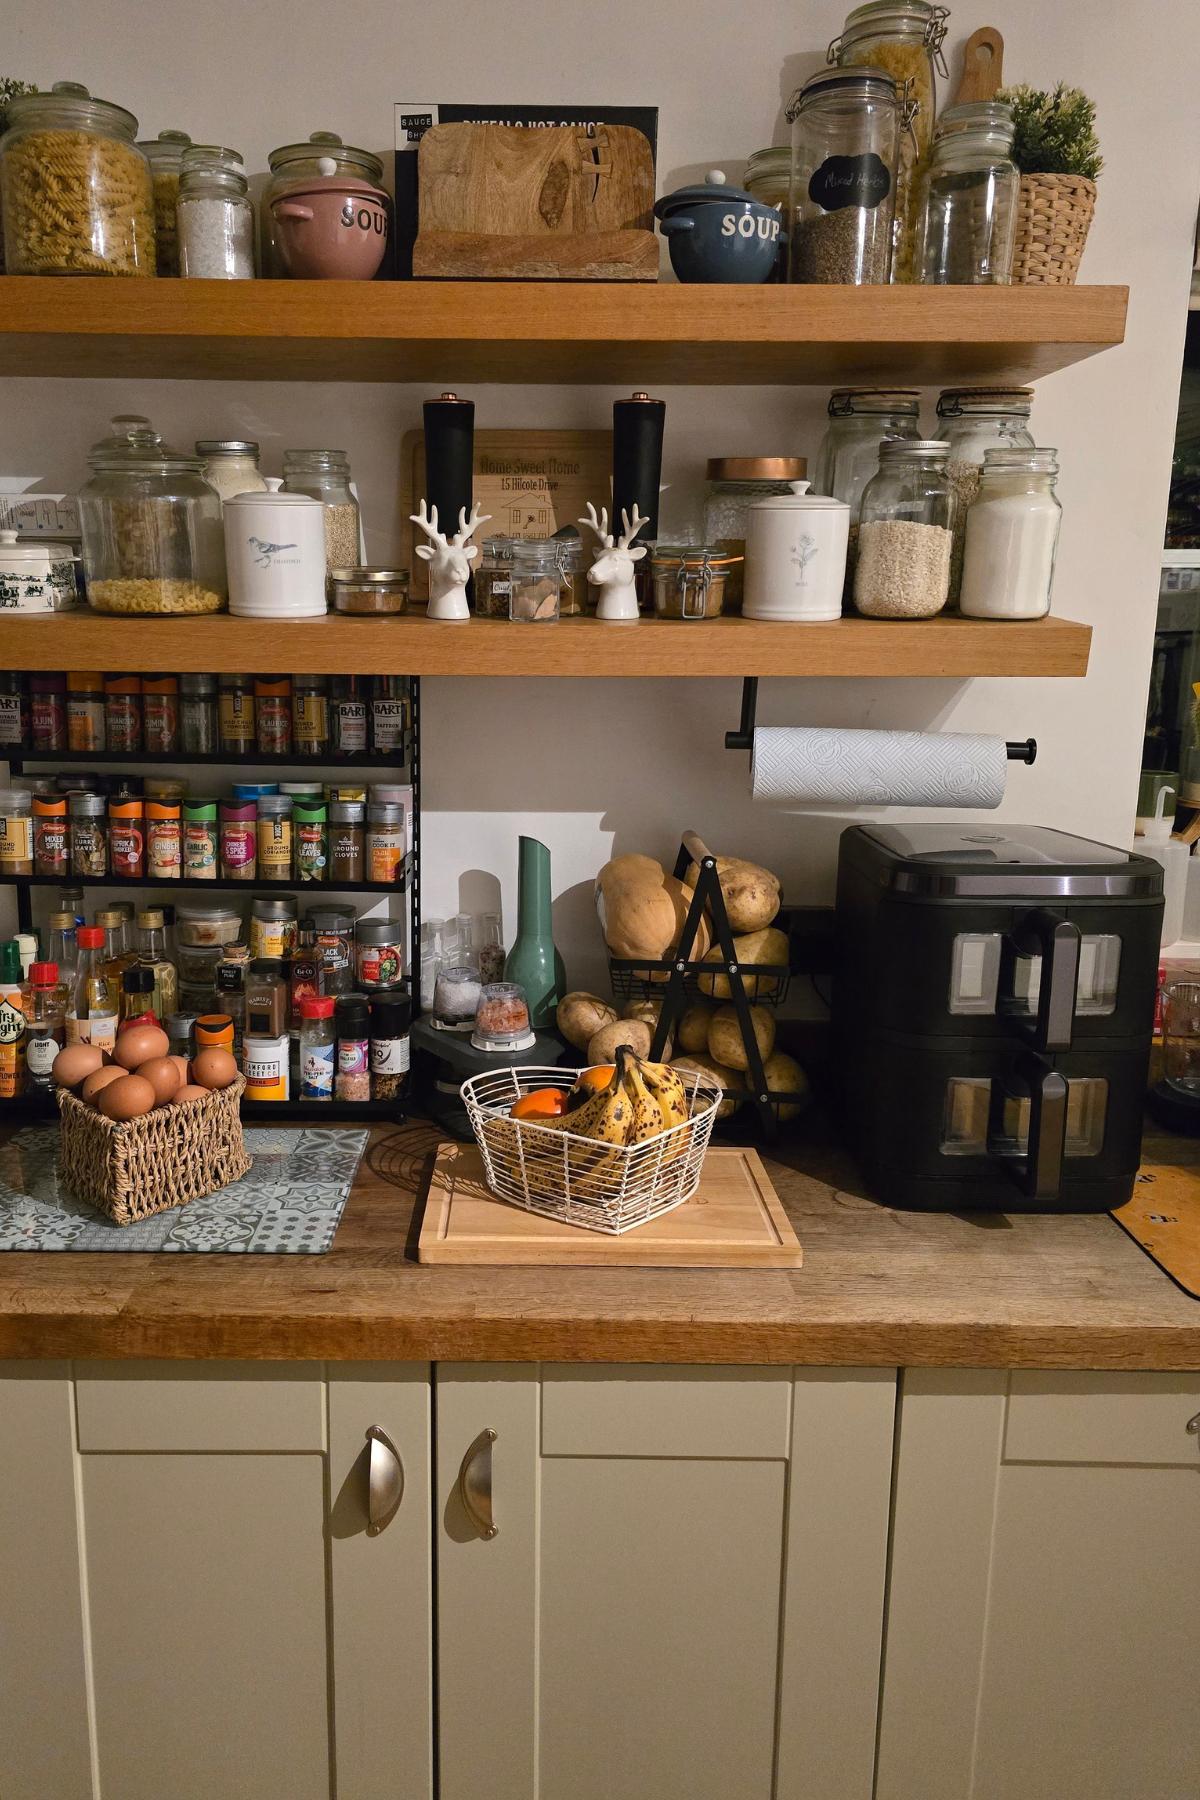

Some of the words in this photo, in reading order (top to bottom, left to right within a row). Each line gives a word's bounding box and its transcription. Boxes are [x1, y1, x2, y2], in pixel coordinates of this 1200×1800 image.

[402, 118, 432, 126] SAUCE
[408, 131, 424, 139] SHO
[721, 214, 780, 242] SOUP
[480, 456, 512, 475] Home
[514, 459, 546, 475] Sweet
[549, 458, 581, 475] Home
[539, 478, 559, 491] Drive
[0, 699, 18, 710] ART
[375, 704, 401, 715] BART
[341, 706, 366, 717] BART
[299, 849, 321, 857] LEAVES
[0, 1022, 22, 1037] ght
